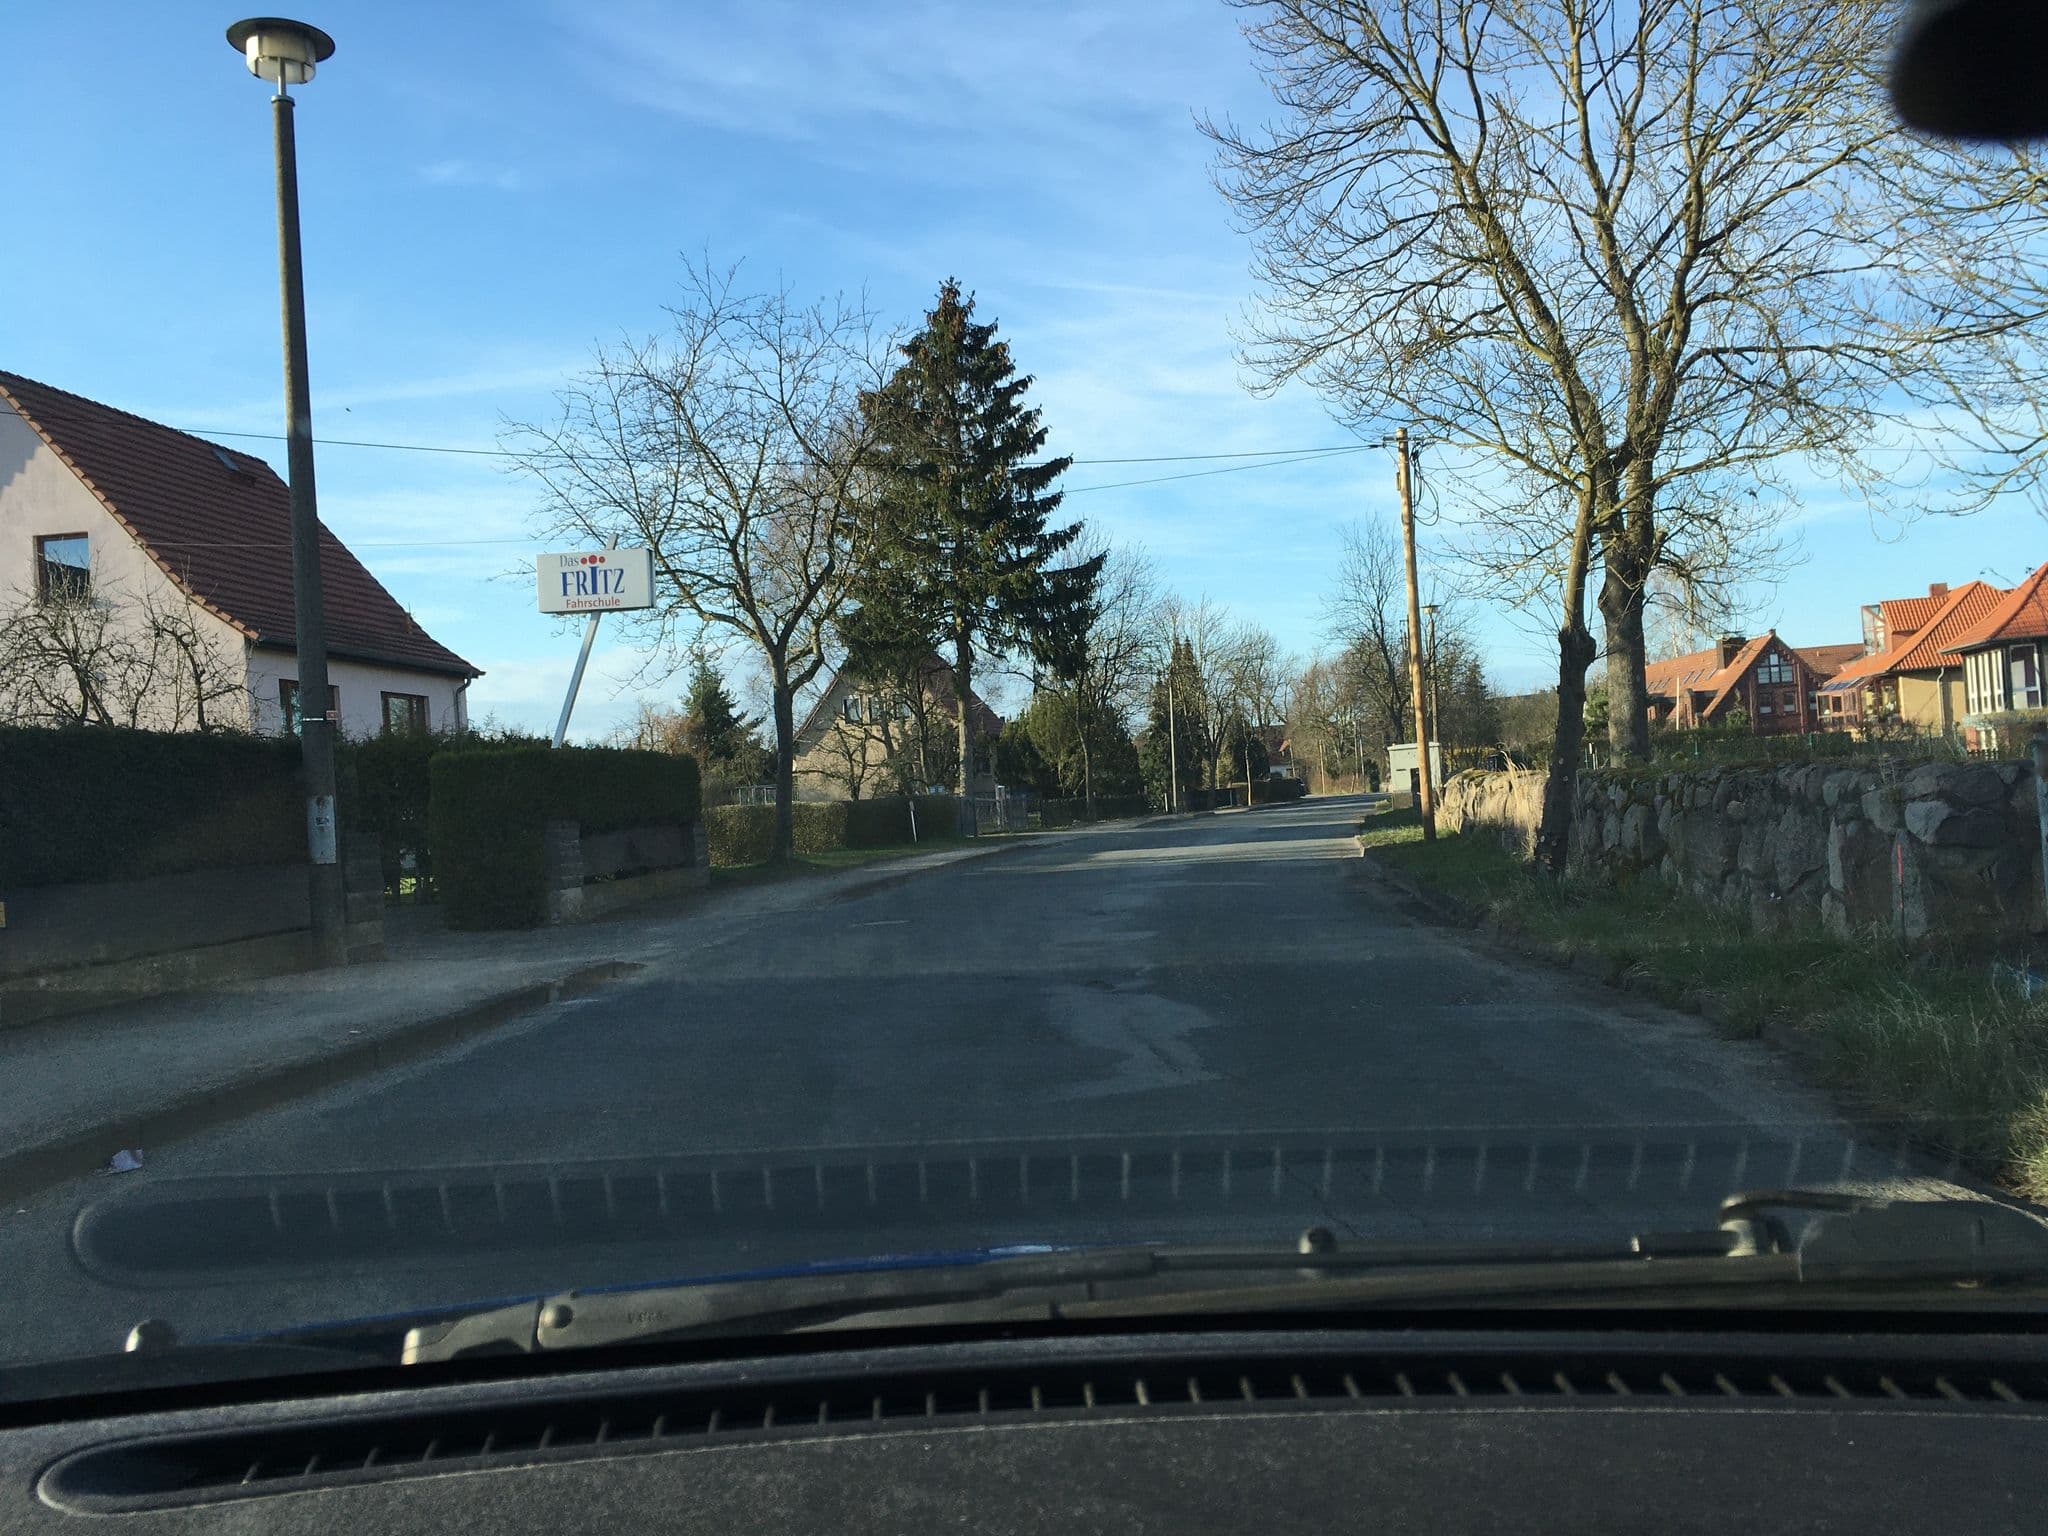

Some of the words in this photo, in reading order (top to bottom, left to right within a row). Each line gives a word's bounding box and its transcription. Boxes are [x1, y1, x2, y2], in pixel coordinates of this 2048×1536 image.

[560, 555, 579, 567] Das
[560, 566, 625, 596] FRITZ
[566, 597, 620, 608] Fahrschule
